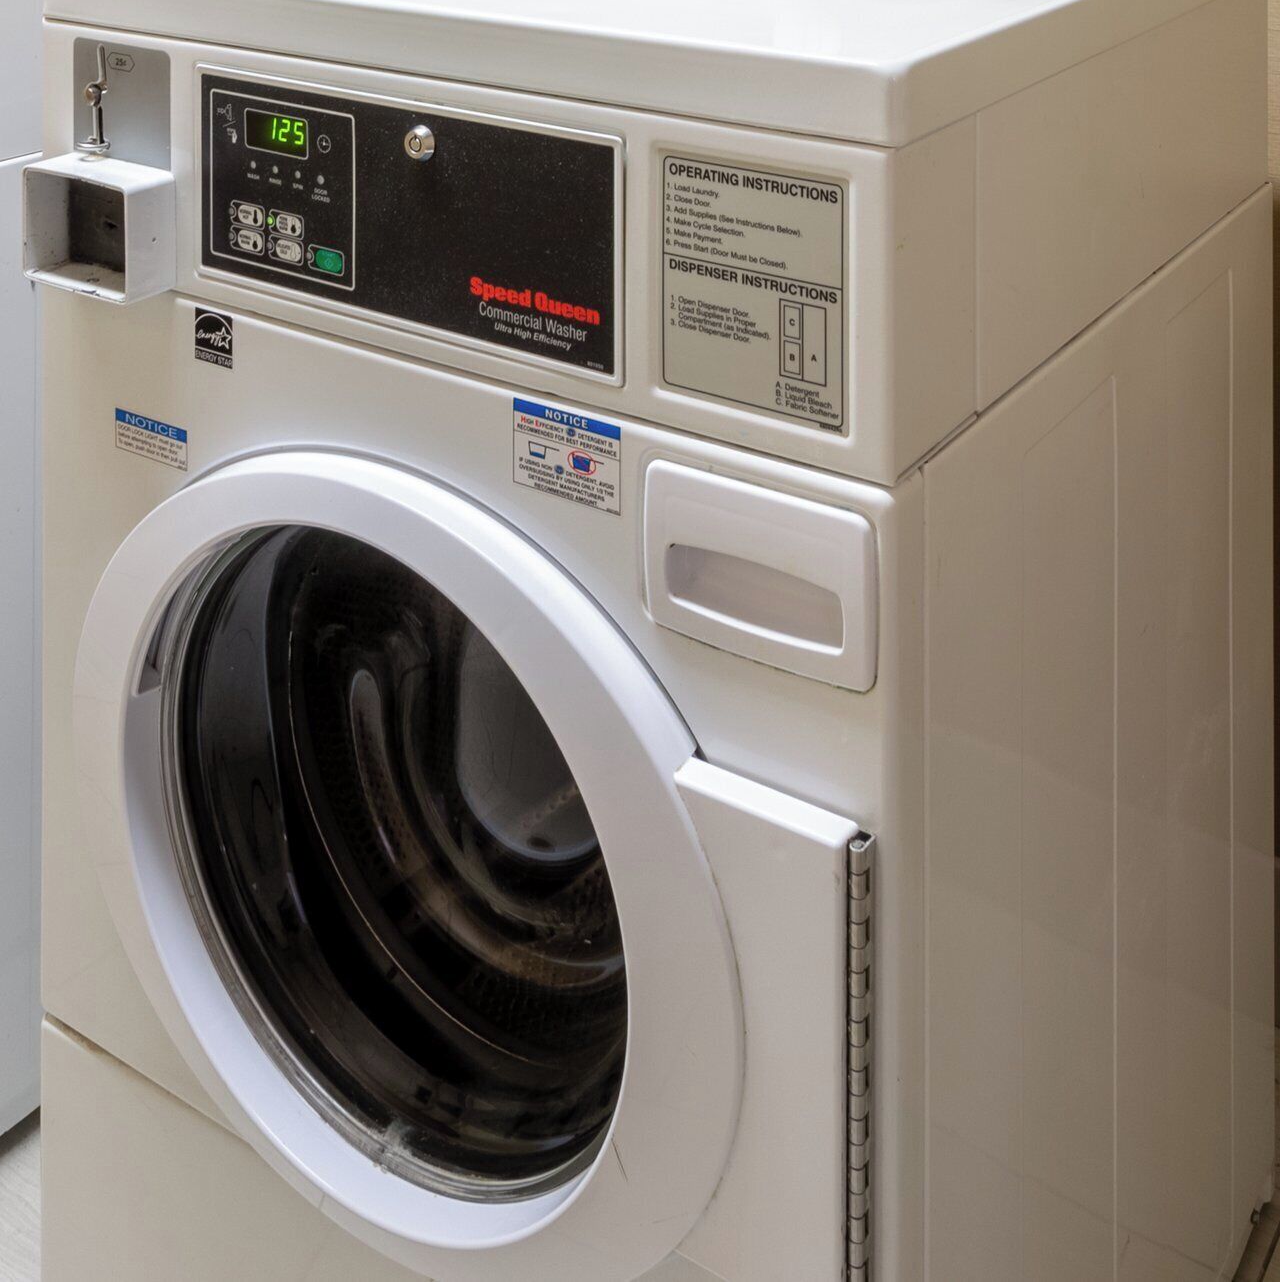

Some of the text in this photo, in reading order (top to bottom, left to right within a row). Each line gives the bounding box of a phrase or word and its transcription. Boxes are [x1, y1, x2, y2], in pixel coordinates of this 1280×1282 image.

[272, 118, 304, 145] 125
[669, 163, 838, 204] OPERATING INSTRUCTIONS
[674, 183, 691, 193] Load
[692, 186, 720, 199] Laundry.
[312, 194, 330, 203] LOCKED
[674, 194, 692, 205] Close
[694, 199, 711, 208] Door.
[674, 206, 687, 215] Add
[689, 208, 717, 221] Supplies
[719, 214, 734, 224] (See
[736, 217, 775, 232] Instructions
[777, 224, 803, 238] Below).
[674, 217, 692, 227] Make
[693, 220, 711, 232] Cycle
[713, 224, 745, 238] Selection.
[674, 228, 692, 239] Make
[693, 232, 723, 245] Payment.
[674, 240, 692, 250] Press
[693, 243, 709, 253] Start
[710, 246, 729, 257] (Door
[731, 251, 747, 261] Must
[749, 254, 758, 263] be
[759, 256, 788, 271] Closed).
[669, 258, 838, 304] DISPENSER INSTRUCTIONS
[469, 276, 600, 325] Speed Queen
[678, 296, 696, 307] Open
[698, 299, 730, 315] Dispenser
[732, 307, 750, 318] Door.
[479, 301, 587, 343] Commercial Washer
[678, 305, 694, 315] Load
[696, 309, 724, 321] Supplies
[734, 316, 756, 328] Proper
[678, 312, 722, 329] Compartment
[724, 322, 734, 332] (as
[789, 318, 795, 327] C
[494, 322, 572, 351] Ultra High Efficiency
[678, 320, 697, 331] Close
[698, 324, 731, 339] Dispenser
[733, 333, 751, 343] Door.
[195, 350, 232, 367] ENERGY STAR
[789, 353, 795, 361] B
[811, 354, 817, 362] A
[775, 381, 819, 398] A. Detergent
[775, 389, 832, 410] B. Liquid Bleach
[545, 409, 588, 428] NOTICE
[775, 397, 839, 420] C. Fabric Softener
[125, 413, 177, 438] NOTICE
[516, 424, 554, 439] RECOMMENDED
[555, 433, 565, 442] FOR
[566, 437, 579, 446] BEST
[580, 441, 617, 458] PERFORMANCE
[578, 432, 607, 446] DETERGENT
[608, 440, 613, 448] IS
[525, 458, 540, 468] USING
[541, 463, 552, 471] NON
[599, 481, 615, 490] AVOID
[528, 472, 605, 503] DETERGENT MANUFACTURERS
[534, 482, 574, 500] RECOMMENDED
[564, 476, 580, 487] USING
[581, 482, 595, 492] ONLY
[604, 488, 615, 498] THE
